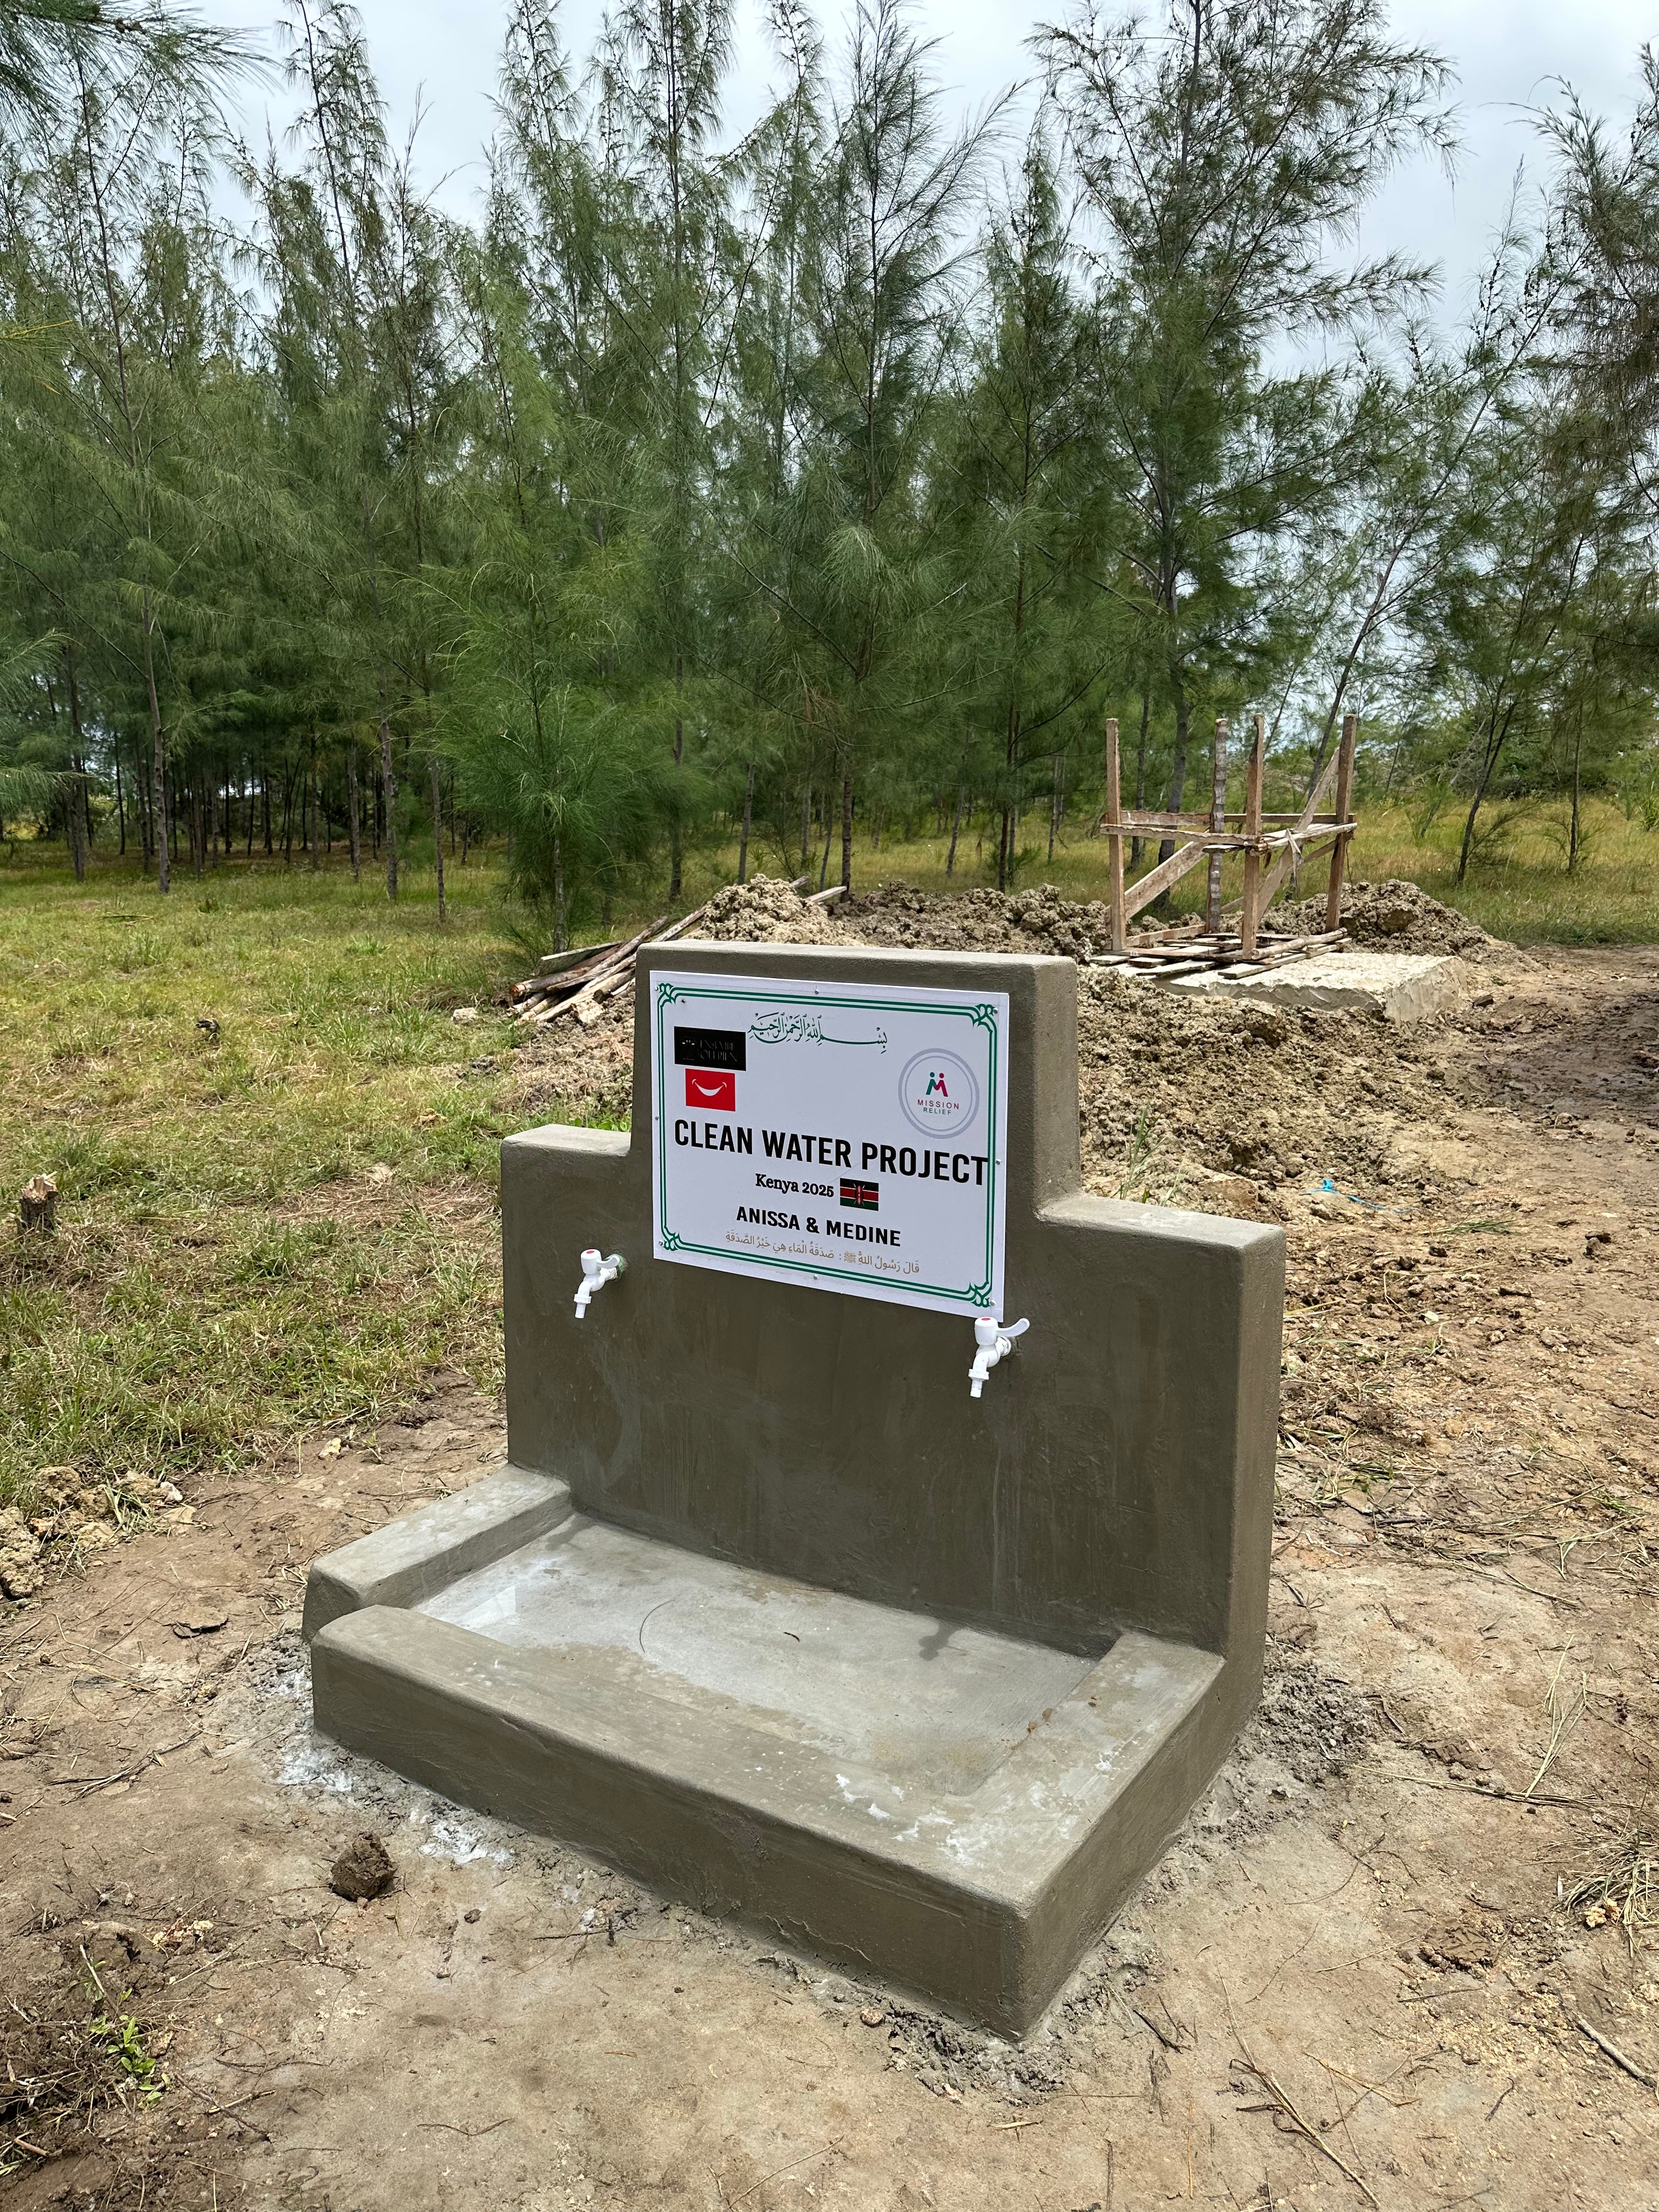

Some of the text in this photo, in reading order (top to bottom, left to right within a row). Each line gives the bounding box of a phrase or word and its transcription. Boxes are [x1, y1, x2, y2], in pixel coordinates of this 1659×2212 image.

[917, 1099, 959, 1110] MISSION
[923, 1107, 952, 1115] RELIEF
[675, 1119, 988, 1186] CLEAN WATER PROJECT
[755, 1173, 834, 1198] Kenya 2025
[736, 1206, 901, 1247] ANISSA & MEDINE
